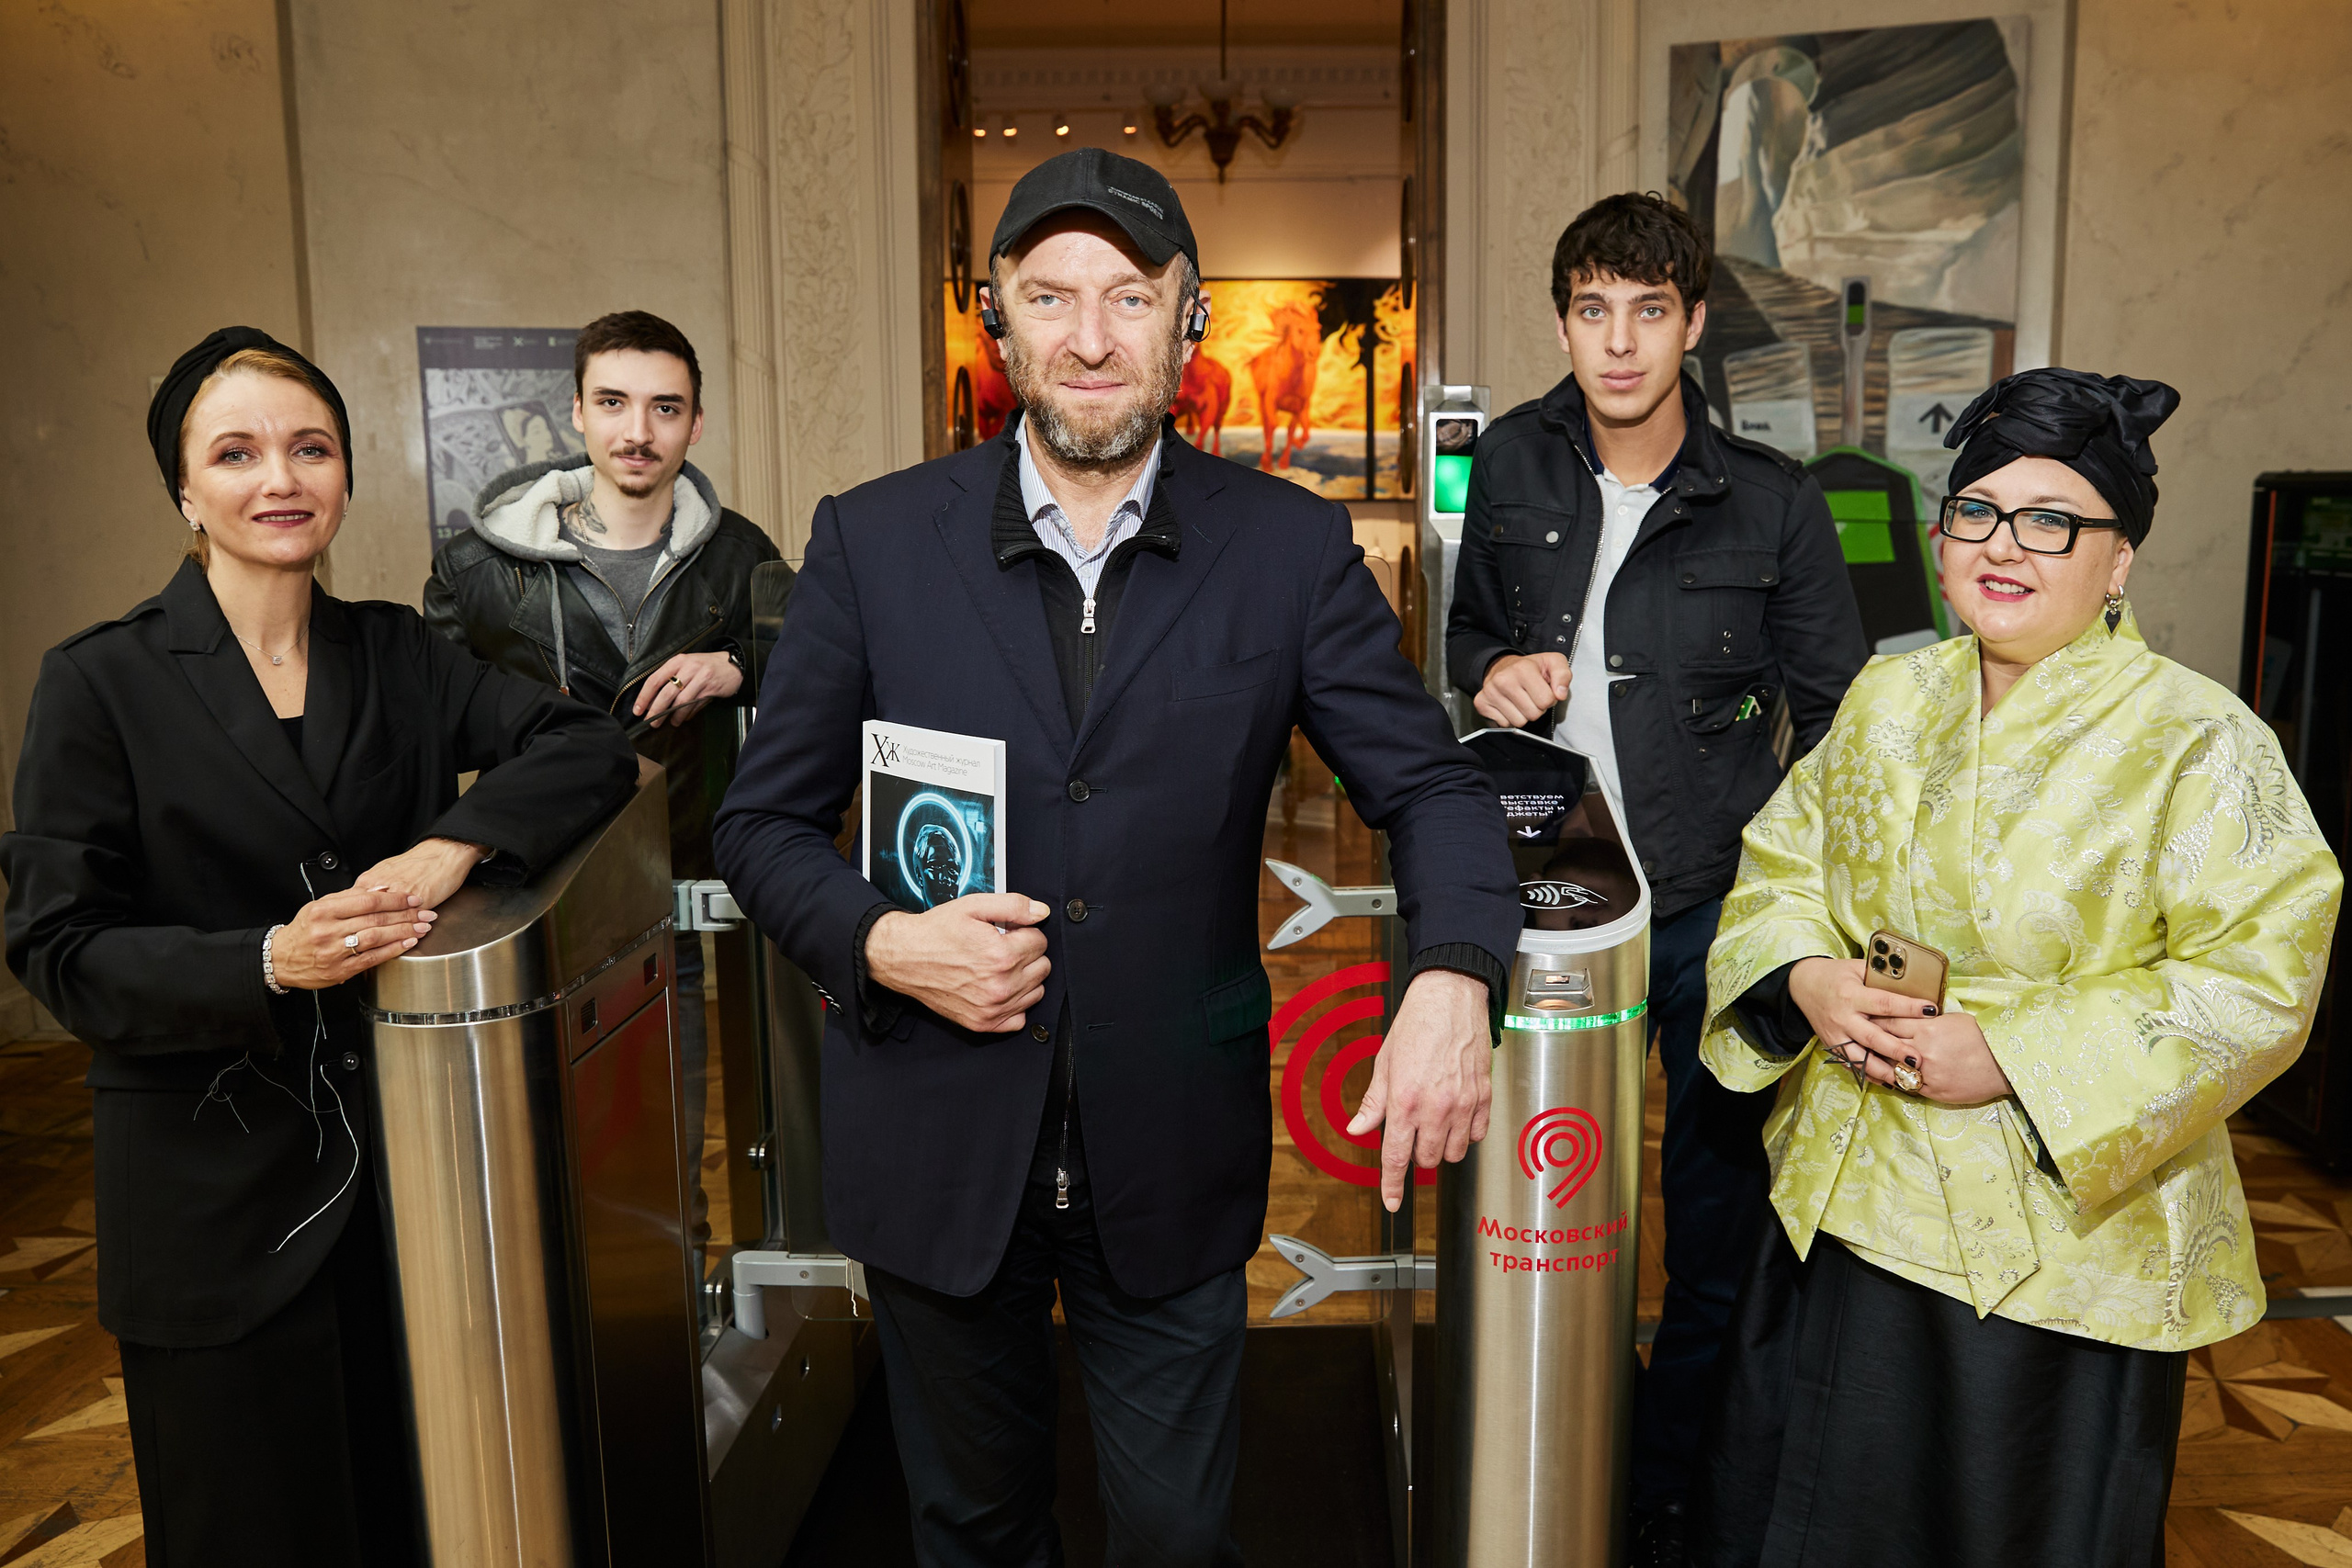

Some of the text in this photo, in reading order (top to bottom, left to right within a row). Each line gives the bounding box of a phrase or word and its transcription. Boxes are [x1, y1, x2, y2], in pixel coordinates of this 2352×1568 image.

[902, 745, 980, 768] Художественный журнал
[902, 756, 926, 769] Moscow
[938, 763, 968, 777] Magazine
[1477, 1210, 1628, 1245] Московский
[1489, 1248, 1619, 1273] транспорт
